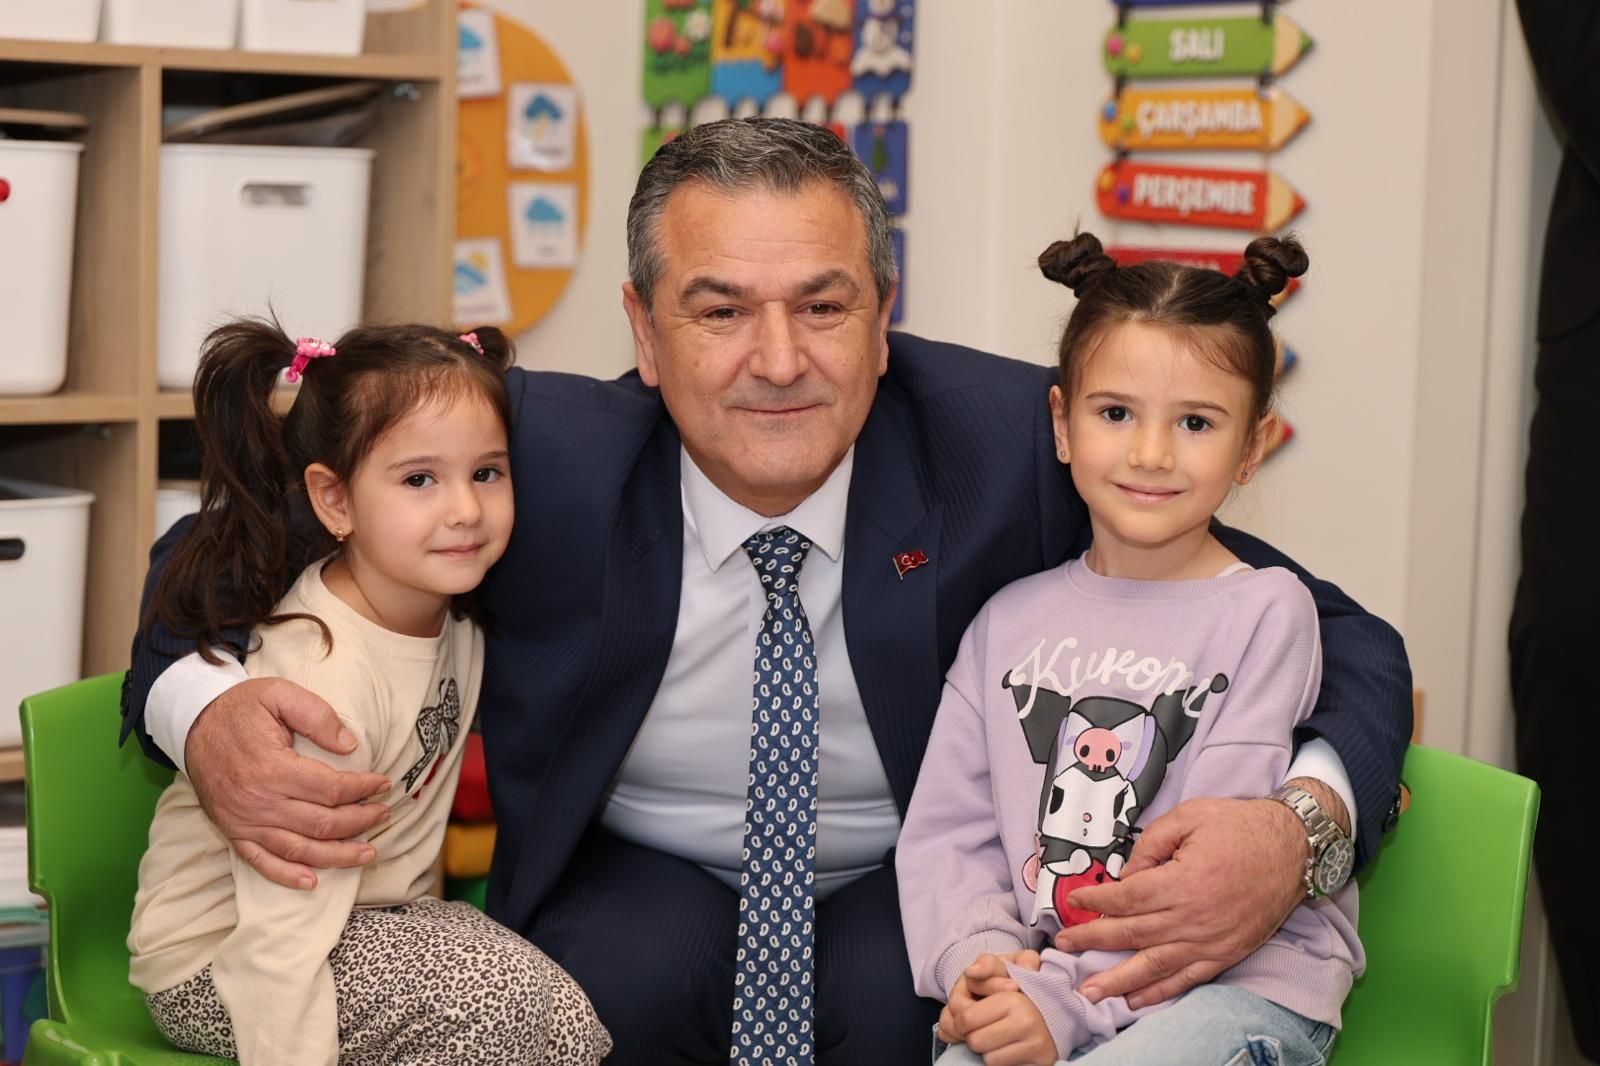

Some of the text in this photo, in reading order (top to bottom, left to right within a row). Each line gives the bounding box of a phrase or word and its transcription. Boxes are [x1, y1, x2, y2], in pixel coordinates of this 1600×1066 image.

[1170, 29, 1224, 61] SALI
[1137, 101, 1262, 138] ÇARŞAMBA
[1134, 174, 1255, 216] PERŞEMBE
